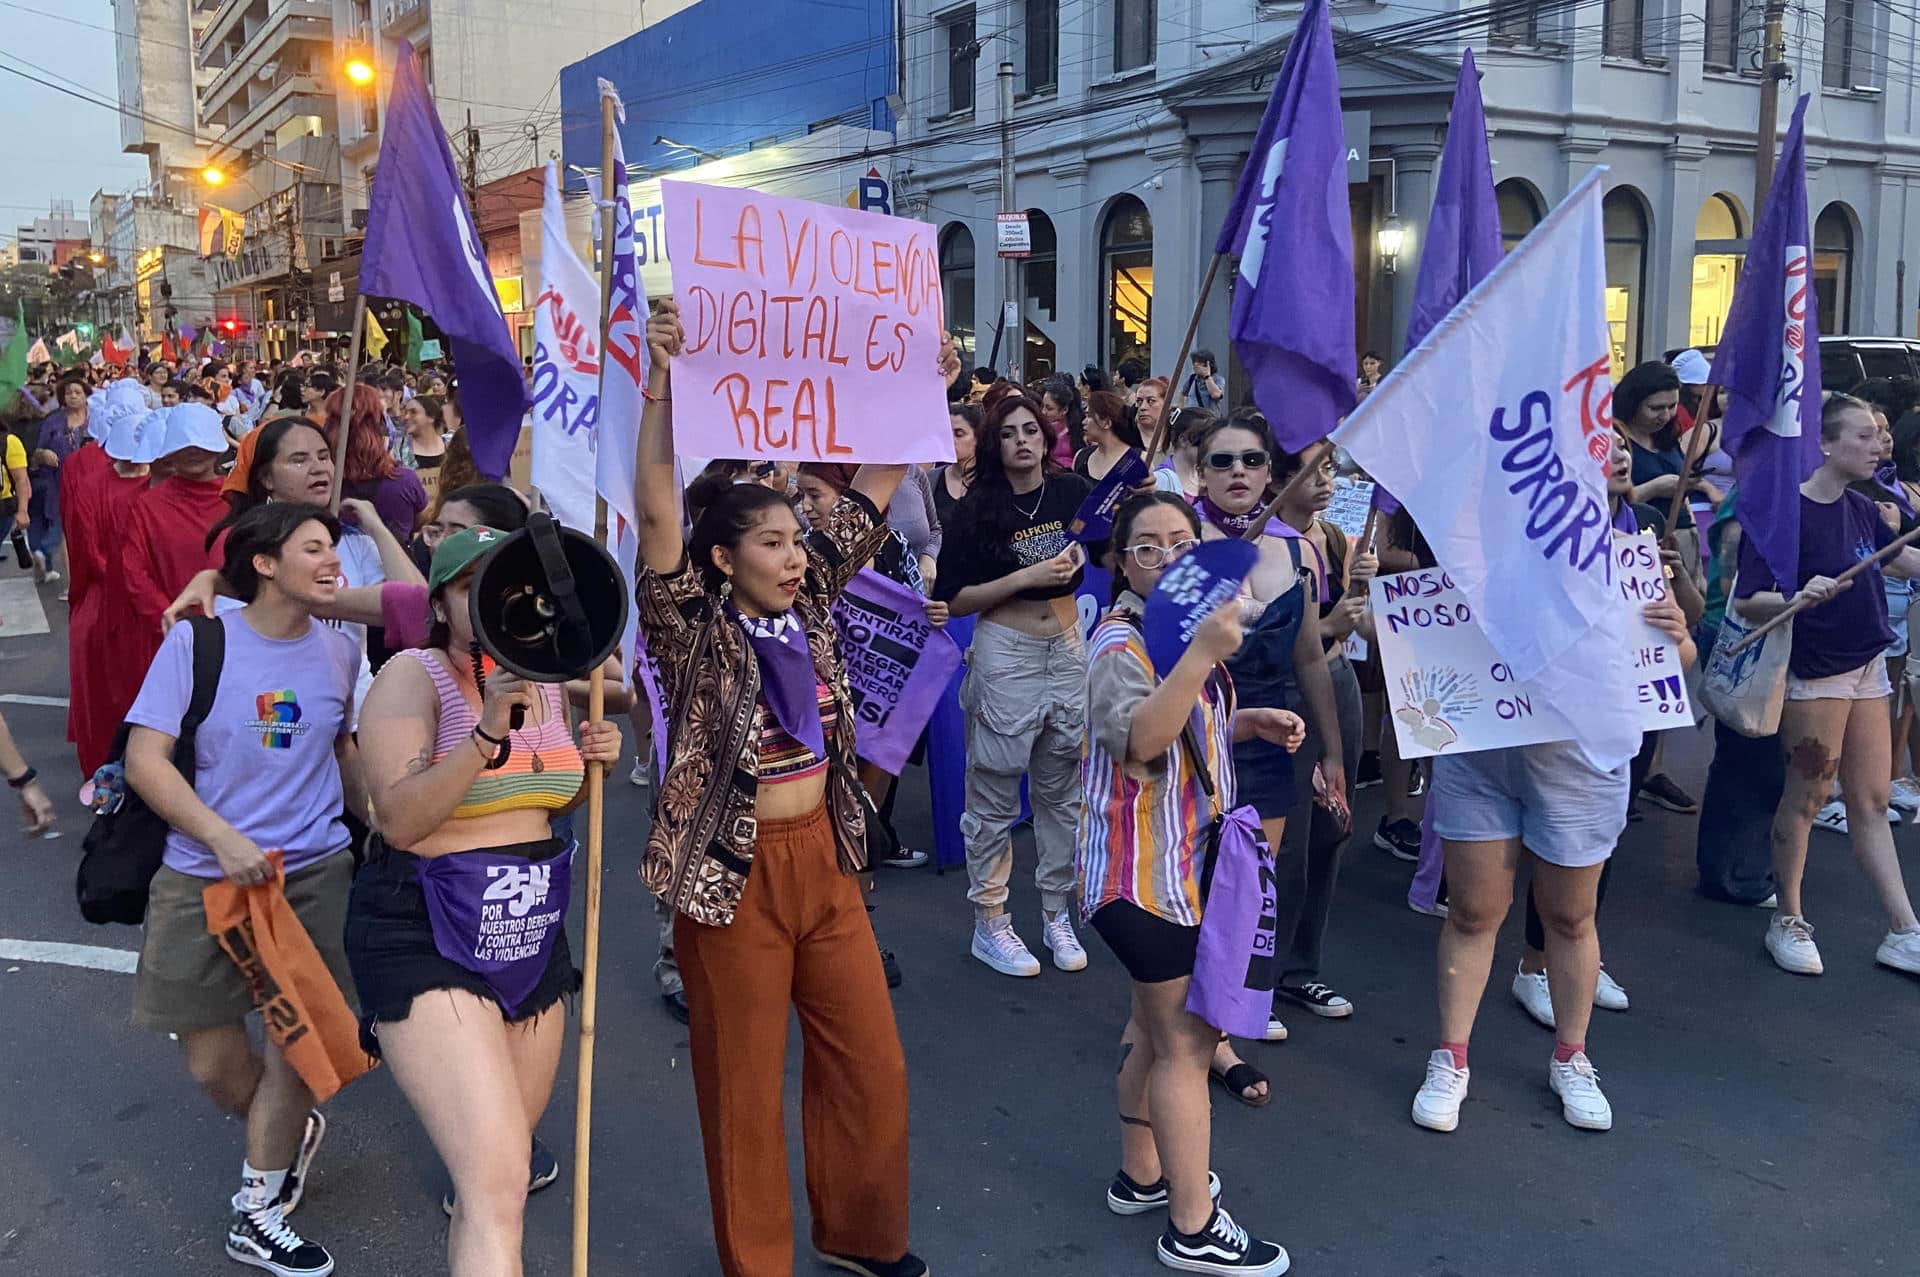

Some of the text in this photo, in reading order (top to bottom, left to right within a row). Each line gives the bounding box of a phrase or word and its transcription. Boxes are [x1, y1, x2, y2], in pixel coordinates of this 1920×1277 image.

[694, 198, 765, 279] LA
[777, 210, 943, 331] VIOLENCIA
[685, 285, 914, 373] DIGITAL ES
[713, 372, 853, 460] REAL
[1489, 389, 1613, 586] SORORA
[1011, 520, 1063, 542] OLFKING
[1616, 544, 1655, 570] OS
[832, 611, 872, 644] NO
[837, 598, 927, 650] MENTIRAS
[896, 613, 930, 639] LAS
[839, 635, 911, 682] ROTEGEN
[1634, 646, 1665, 668] HE
[848, 669, 898, 704] ÉNERO
[859, 701, 896, 728] SÍ
[479, 909, 561, 935] NUESTROS DERECHOS
[481, 904, 503, 921] POR
[474, 941, 541, 961] LAS VIOLENCIAS
[477, 927, 547, 948] Y CONTRA TODAS
